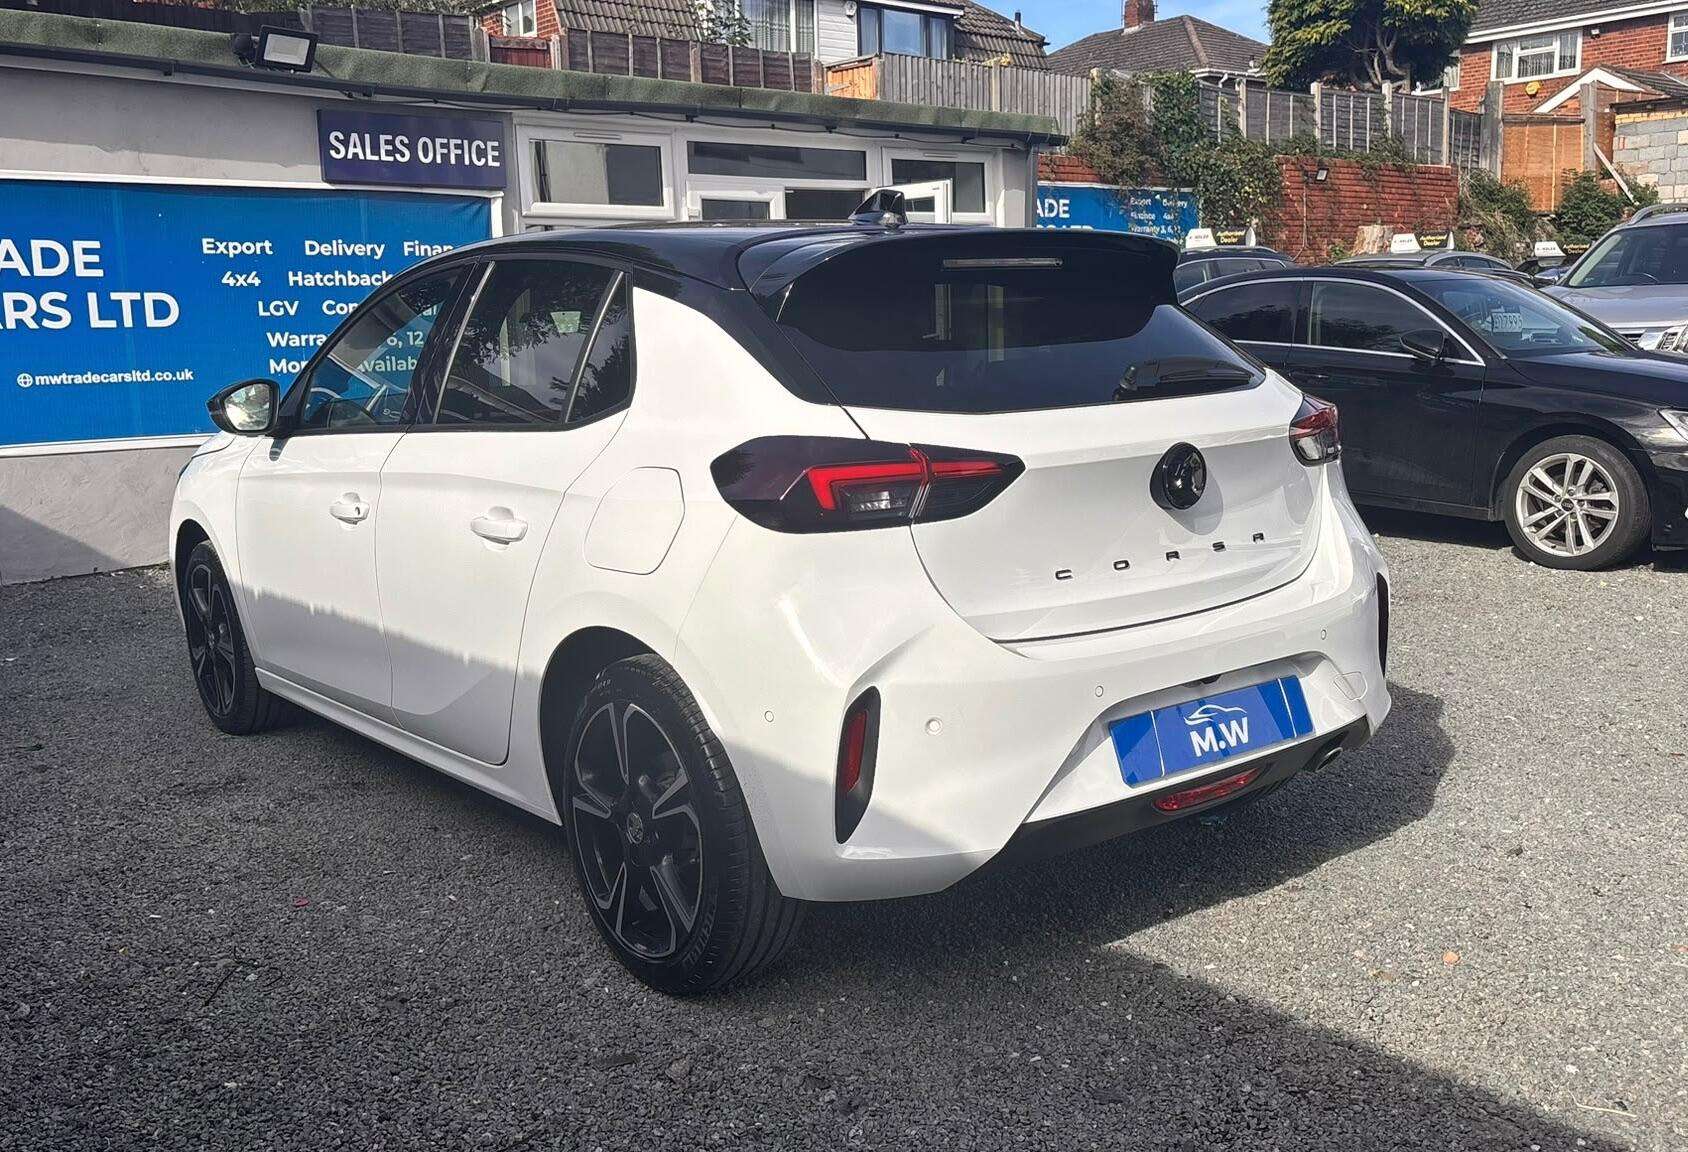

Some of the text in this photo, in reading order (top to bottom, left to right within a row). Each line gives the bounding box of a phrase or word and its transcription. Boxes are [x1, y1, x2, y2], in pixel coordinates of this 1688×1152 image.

[329, 131, 501, 167] SALES OFFICE
[202, 238, 274, 257] Export
[305, 239, 385, 259] Delivery
[221, 271, 261, 287] 4x4
[0, 292, 180, 329] RS LTD
[258, 300, 299, 316] LGV
[406, 331, 424, 346] 12
[35, 369, 194, 386] mwtradecarsltd.co.uk
[1055, 532, 1264, 580] CORSA
[1190, 717, 1249, 757] M.W
